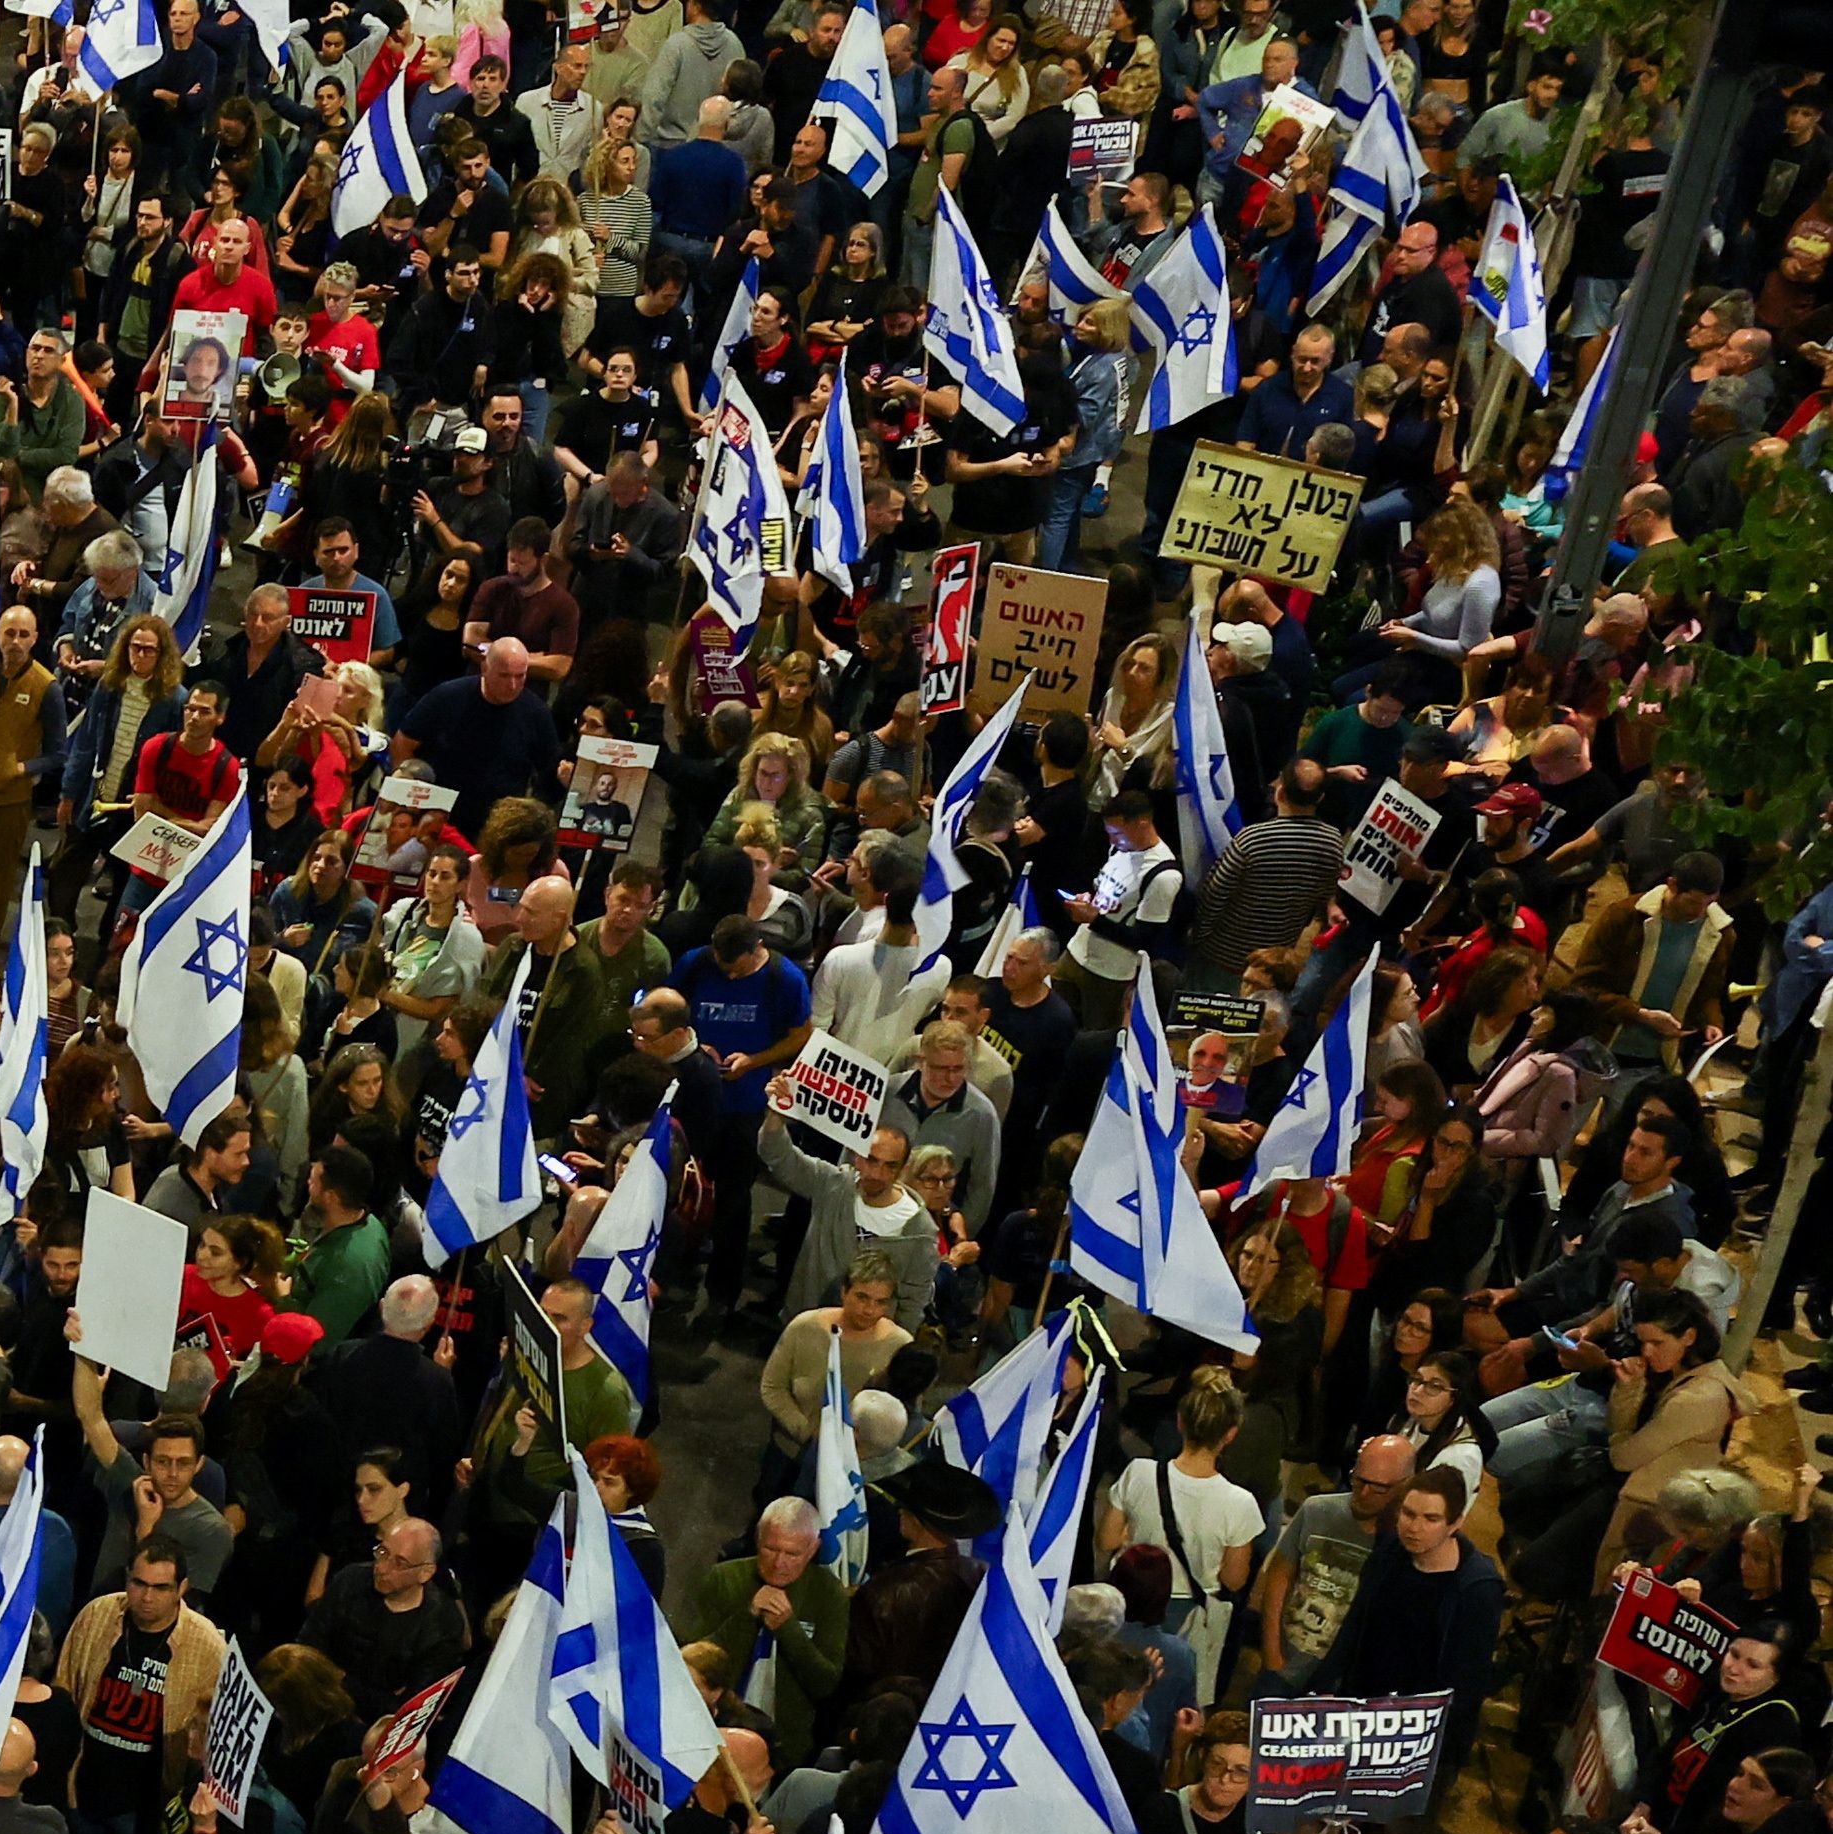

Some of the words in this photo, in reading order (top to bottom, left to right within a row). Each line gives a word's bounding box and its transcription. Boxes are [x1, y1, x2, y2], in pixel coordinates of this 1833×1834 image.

[1194, 460, 1263, 502] חרדי
[1283, 472, 1354, 520] בטלן
[1230, 500, 1282, 536] לא
[1174, 518, 1269, 568] חשבוני
[1277, 540, 1321, 582] על
[308, 597, 345, 614] תרופה
[346, 600, 366, 617] אין
[999, 599, 1085, 633] האשם
[1014, 629, 1078, 660] חייב
[990, 654, 1081, 695] לשלם
[1370, 803, 1423, 850] אותו
[1381, 791, 1431, 833] מחליפים
[137, 842, 182, 868] NOW
[814, 1045, 885, 1101] נתניהו
[794, 1085, 874, 1140] לעסקה
[1638, 1614, 1712, 1676] לאונס!
[1674, 1606, 1726, 1650] תרופה
[222, 1653, 265, 1740] SAVE
[1260, 1711, 1319, 1742] אש
[1323, 1705, 1444, 1743] הפסקת
[1259, 1743, 1346, 1760] CEASEFIRE
[1348, 1731, 1436, 1767] עכשיו
